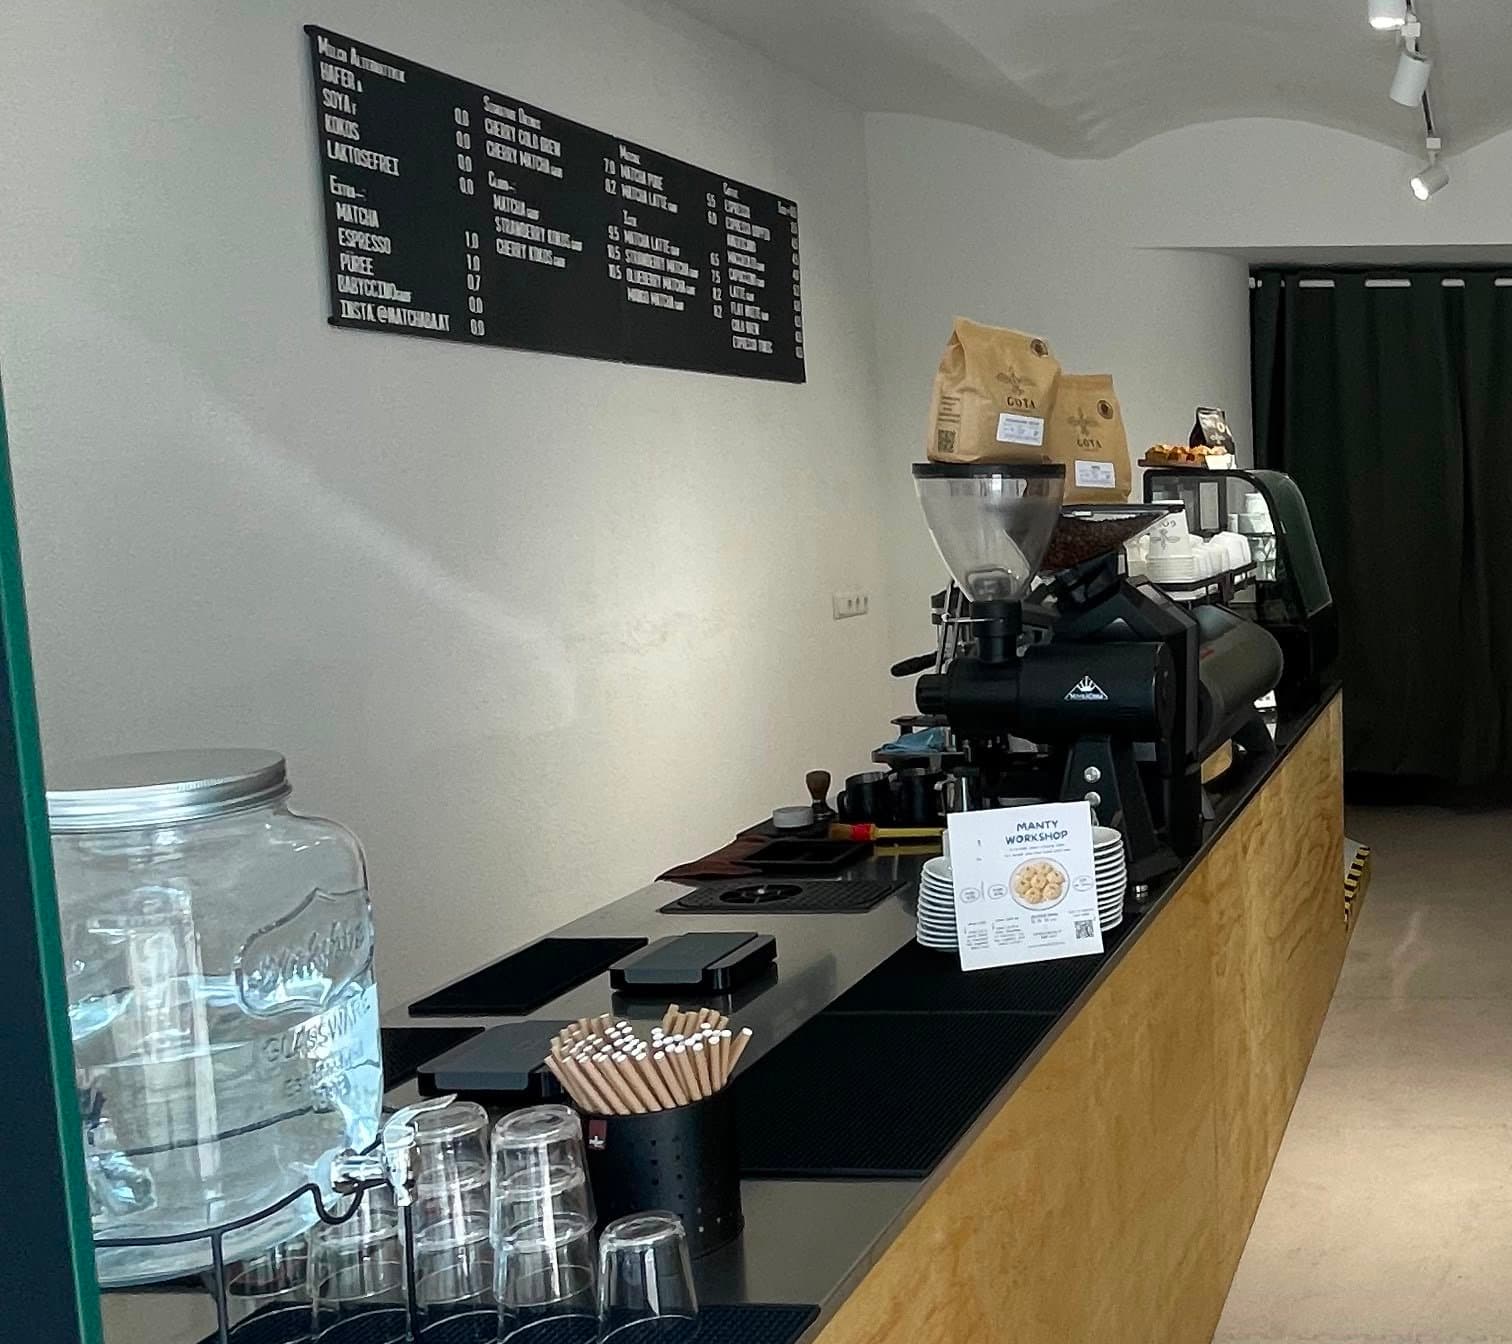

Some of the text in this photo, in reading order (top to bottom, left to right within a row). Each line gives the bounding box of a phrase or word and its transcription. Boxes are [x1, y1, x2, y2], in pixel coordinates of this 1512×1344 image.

[324, 113, 359, 141] KOKOS
[336, 202, 379, 228] MATCHA
[338, 228, 391, 254] ESPRESSO
[1007, 396, 1036, 409] GOTA
[1016, 820, 1059, 832] MANTY
[1005, 830, 1068, 845] WORKSHOP
